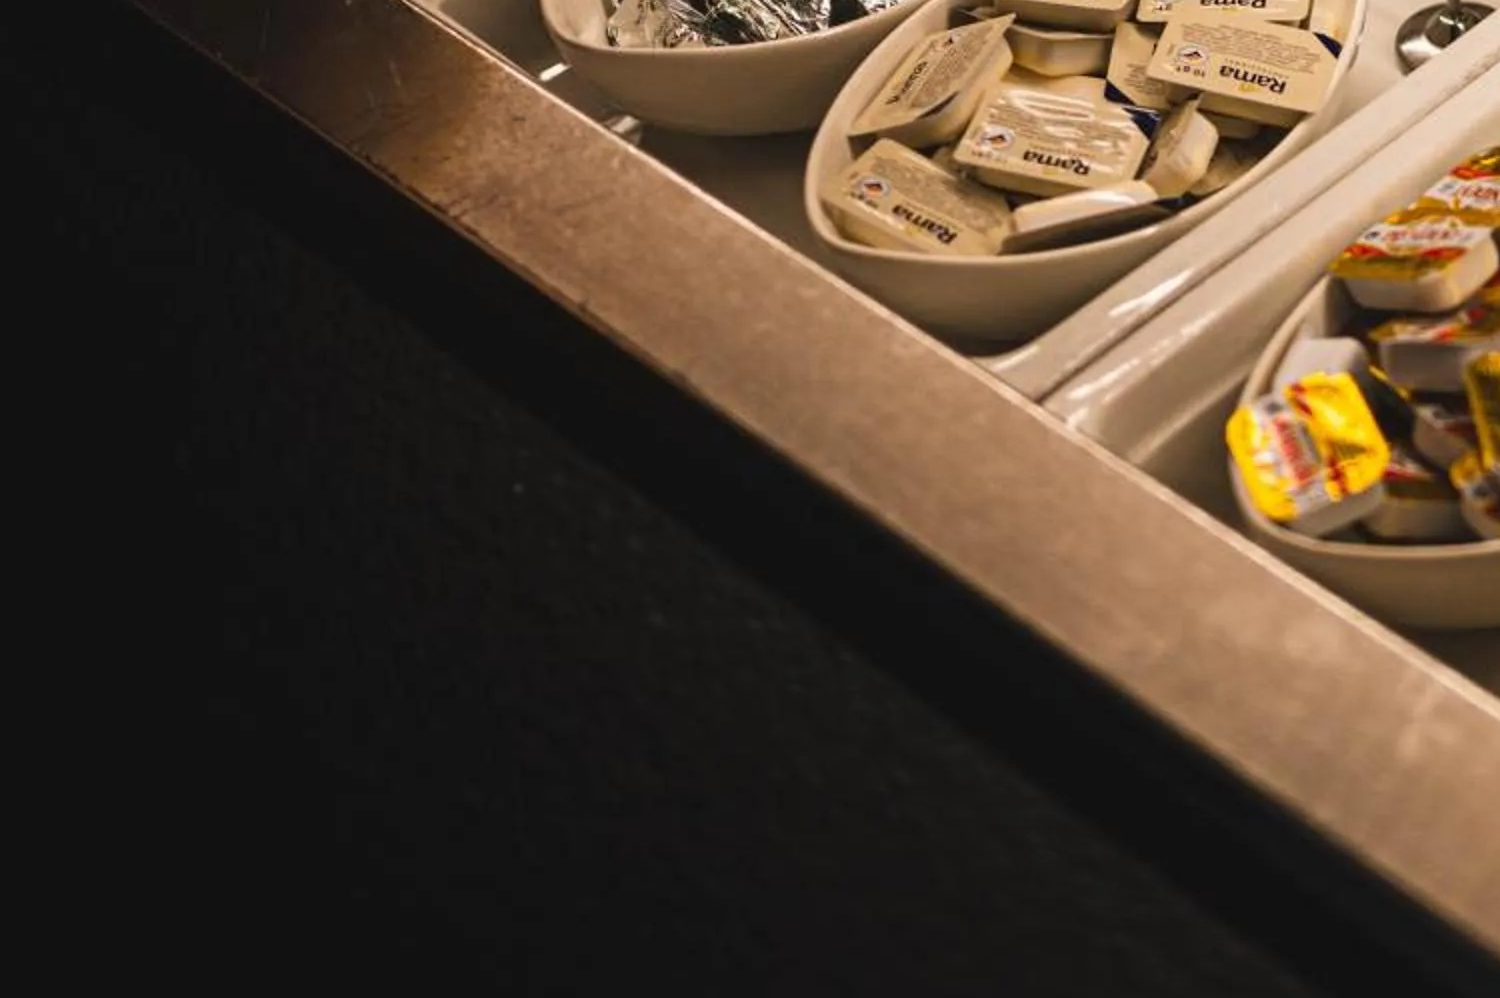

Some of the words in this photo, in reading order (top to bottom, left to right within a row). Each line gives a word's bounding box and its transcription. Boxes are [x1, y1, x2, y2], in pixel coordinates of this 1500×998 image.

[1218, 63, 1288, 95] Rama
[1022, 148, 1091, 177] Rama
[891, 203, 959, 246] Rama
